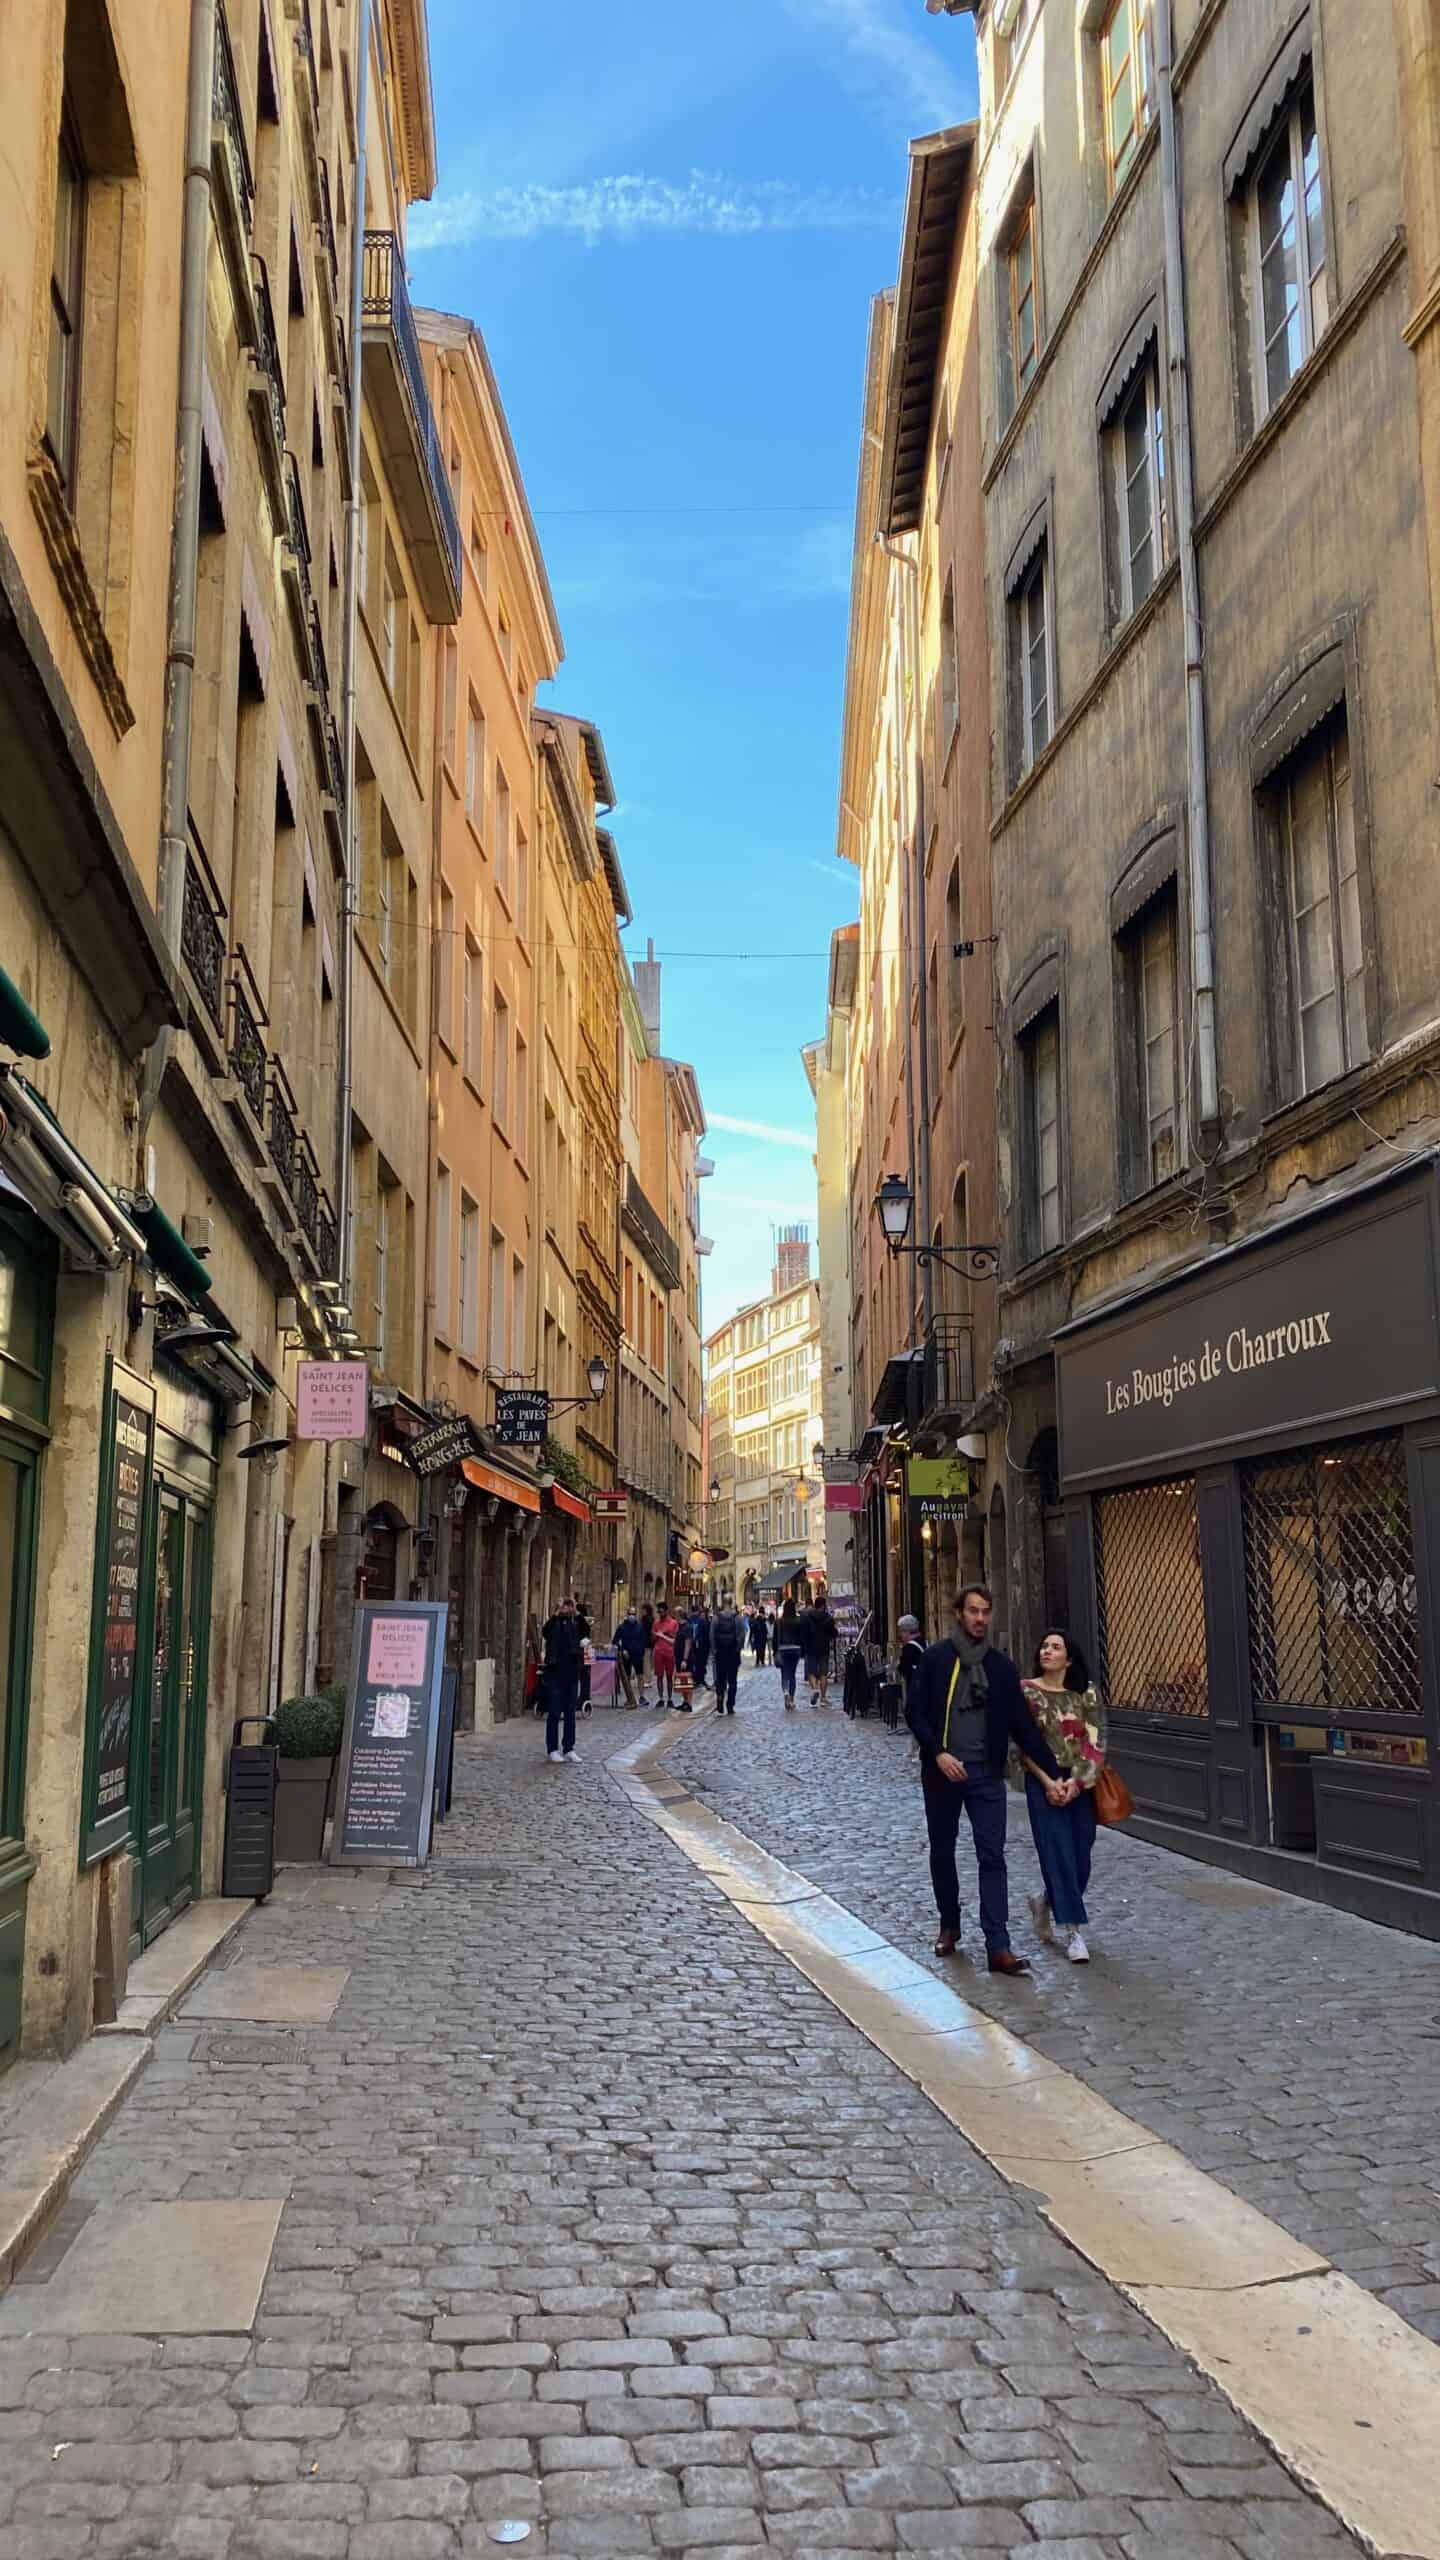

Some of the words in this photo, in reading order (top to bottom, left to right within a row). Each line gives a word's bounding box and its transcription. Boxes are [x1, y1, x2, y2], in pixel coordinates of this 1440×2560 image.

[1105, 1380, 1130, 1415] Les
[1132, 1355, 1196, 1407] Bougies
[1199, 1341, 1221, 1382] de
[1226, 1311, 1332, 1373] Charroux
[302, 1371, 333, 1381] SAINT
[336, 1371, 364, 1381] JEAN
[496, 1391, 547, 1408] RESTAURANT
[497, 1409, 515, 1420] LES
[410, 1421, 467, 1458] RESTAURANT
[516, 1430, 541, 1441] JEAN
